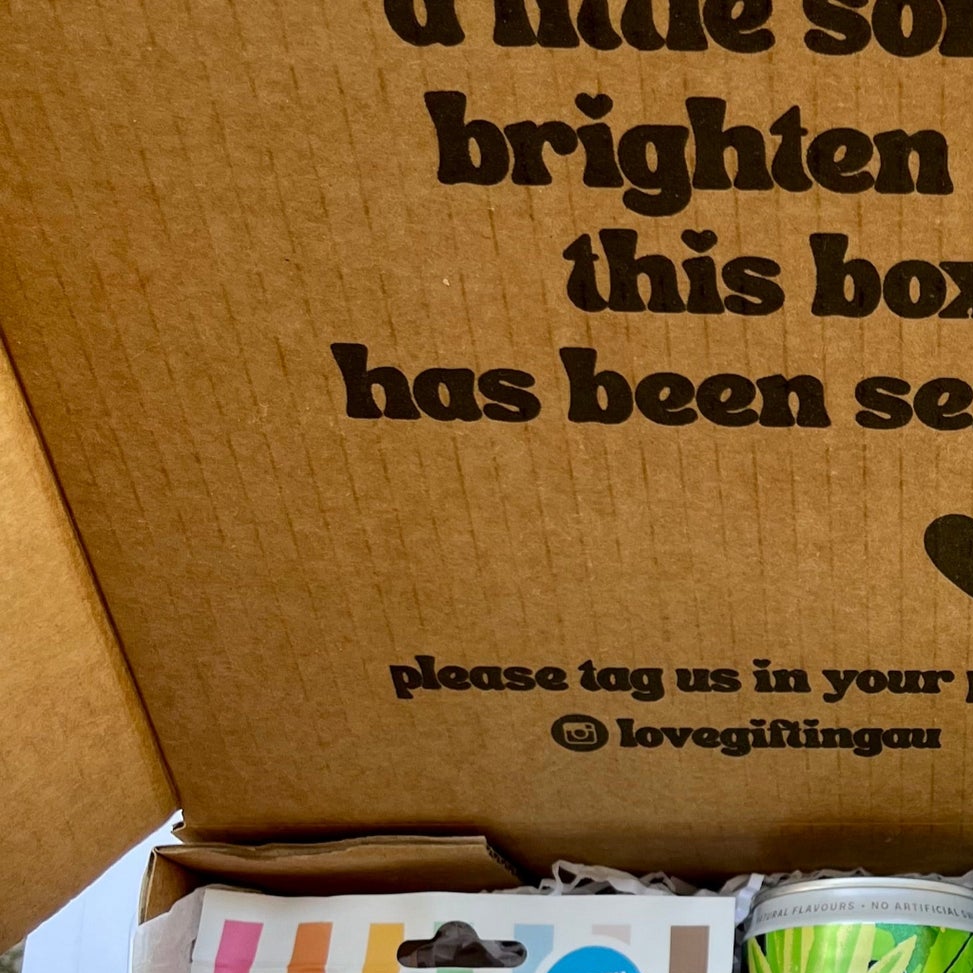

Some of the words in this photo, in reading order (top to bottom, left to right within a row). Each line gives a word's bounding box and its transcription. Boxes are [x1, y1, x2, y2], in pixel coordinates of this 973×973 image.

[424, 91, 954, 217] brighten
[562, 229, 785, 316] this
[330, 343, 541, 422] has
[559, 347, 831, 428] been
[389, 655, 568, 699] please
[578, 660, 664, 702] tag
[675, 666, 742, 693] us
[753, 658, 812, 693] in
[822, 666, 955, 703] your
[615, 718, 942, 757] lovegiftingau
[792, 901, 855, 915] FLAVOURS
[871, 901, 889, 910] NO
[895, 902, 960, 917] ARTIFICIAL
